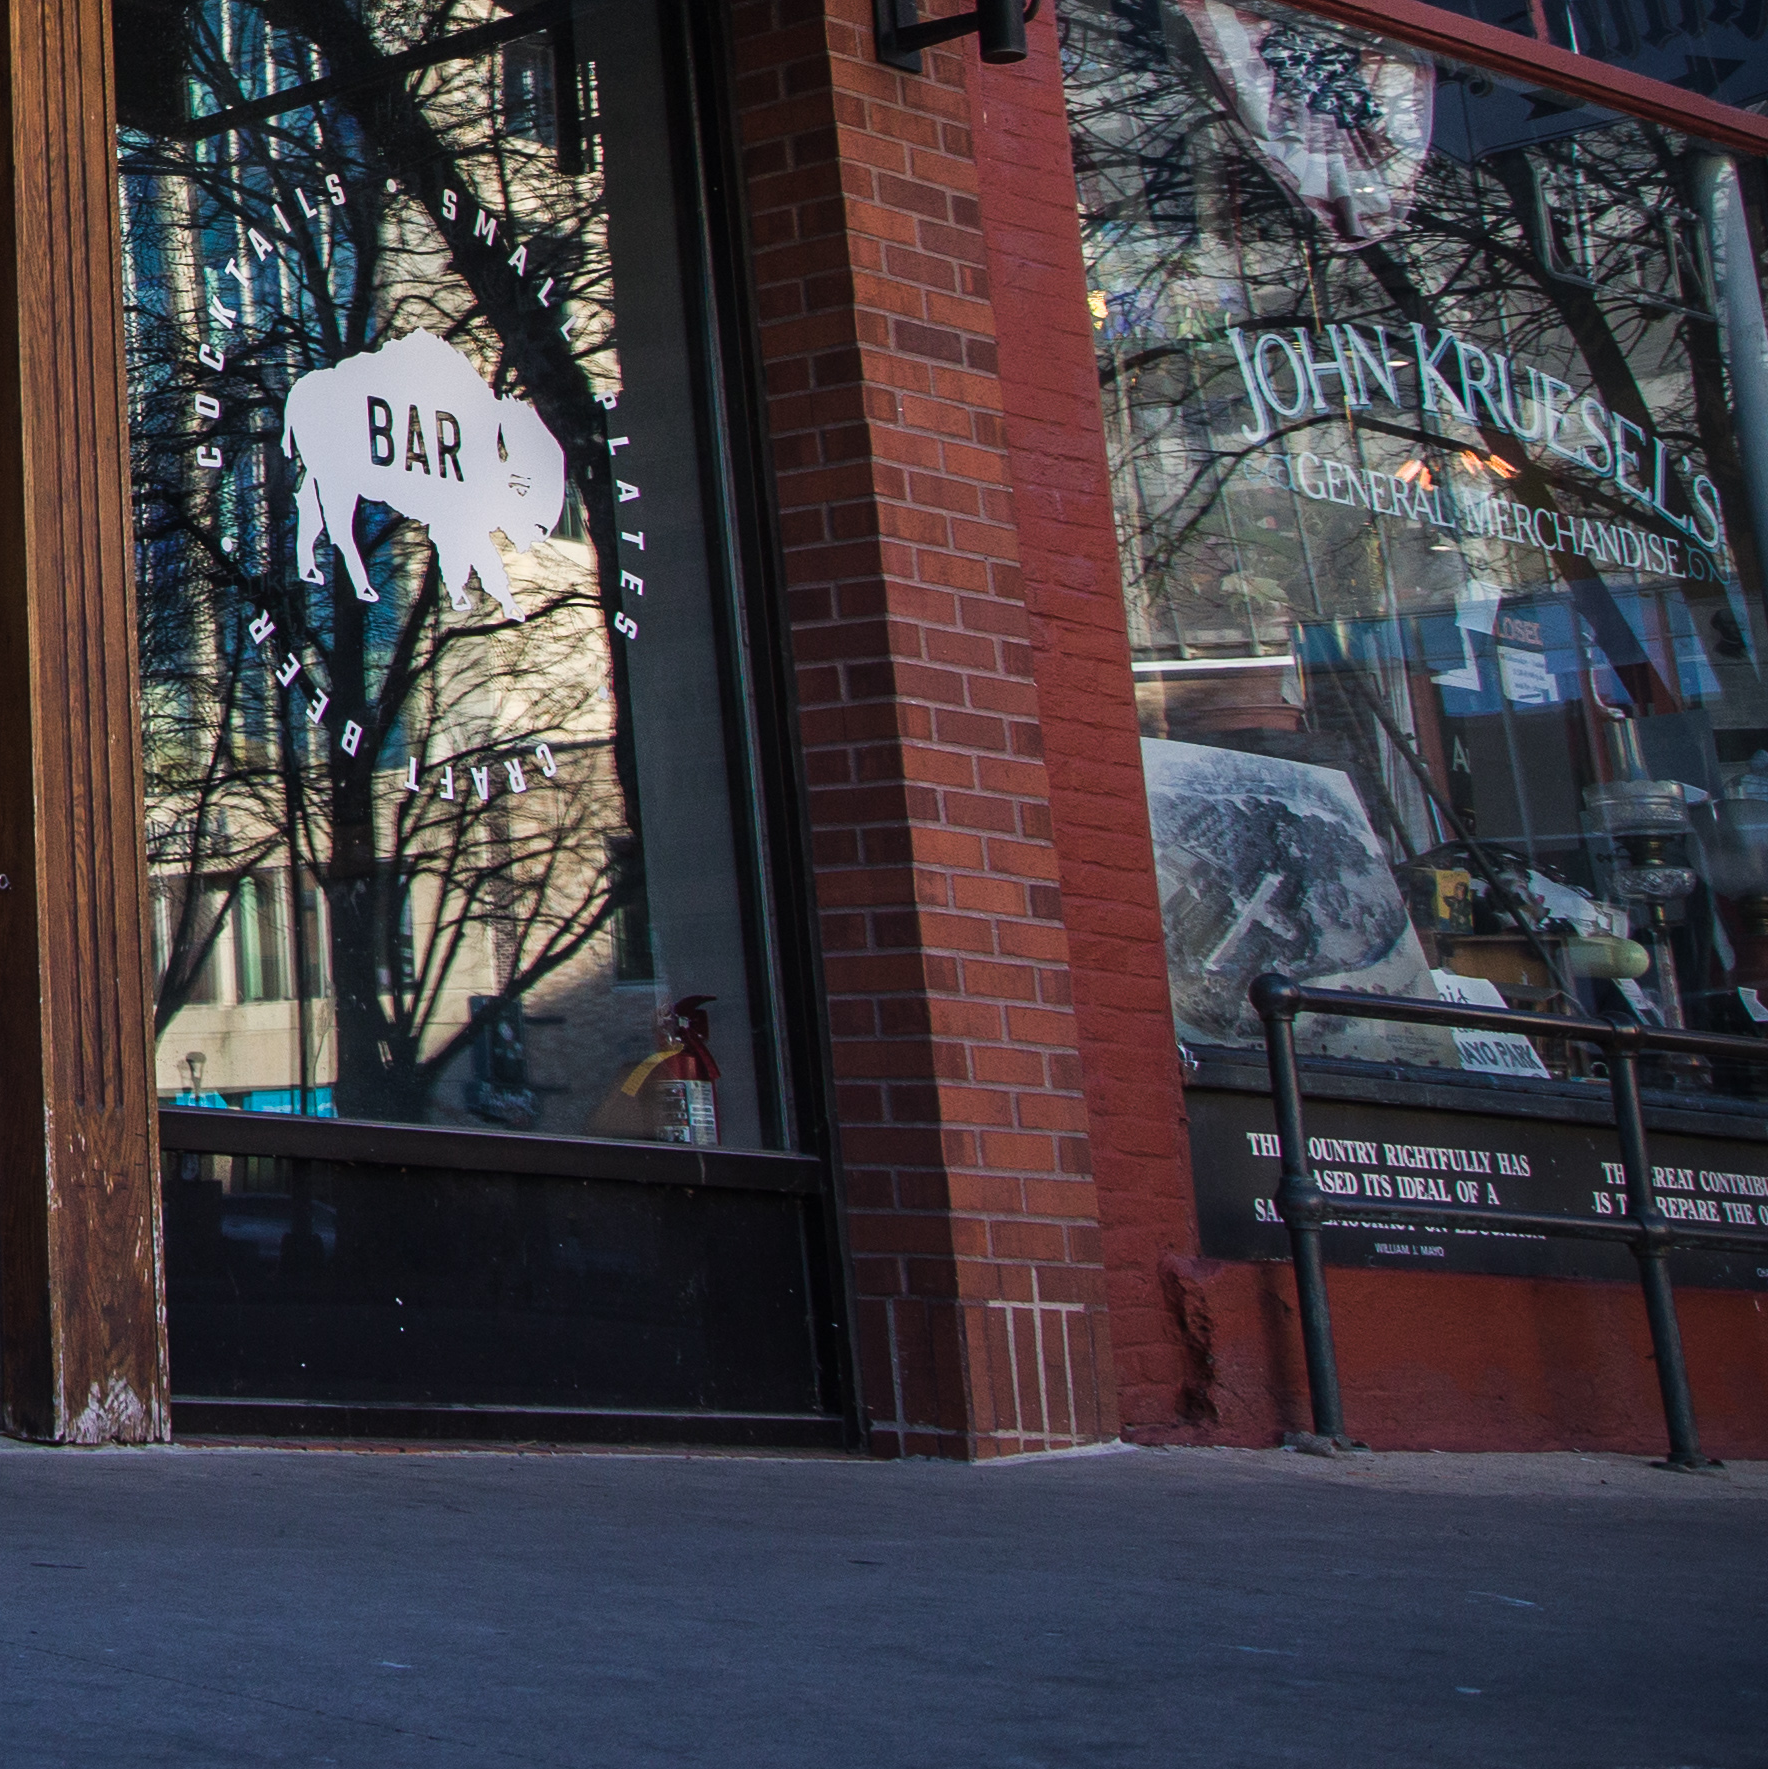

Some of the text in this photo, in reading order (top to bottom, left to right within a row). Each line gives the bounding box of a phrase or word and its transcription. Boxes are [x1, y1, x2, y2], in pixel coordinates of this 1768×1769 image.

[194, 172, 348, 469] COCKTAILS
[366, 395, 464, 483] BAR
[441, 189, 647, 640] SMALL PLATES
[1225, 321, 1725, 553] JOHN KRUESEL'S
[1296, 451, 1687, 580] GENERAL MERCHANDISE
[248, 608, 559, 802] CRAFT BEER
[1246, 1132, 1532, 1177] THI OUNTRY RIGHTFULLY HAS
[1313, 1169, 1501, 1206] ASED ITS IDEAL OF A
[1601, 1161, 1627, 1185] TH
[1651, 1166, 1696, 1191] REAT
[1655, 1195, 1722, 1223] REPARE
[1722, 1201, 1758, 1226] THE
